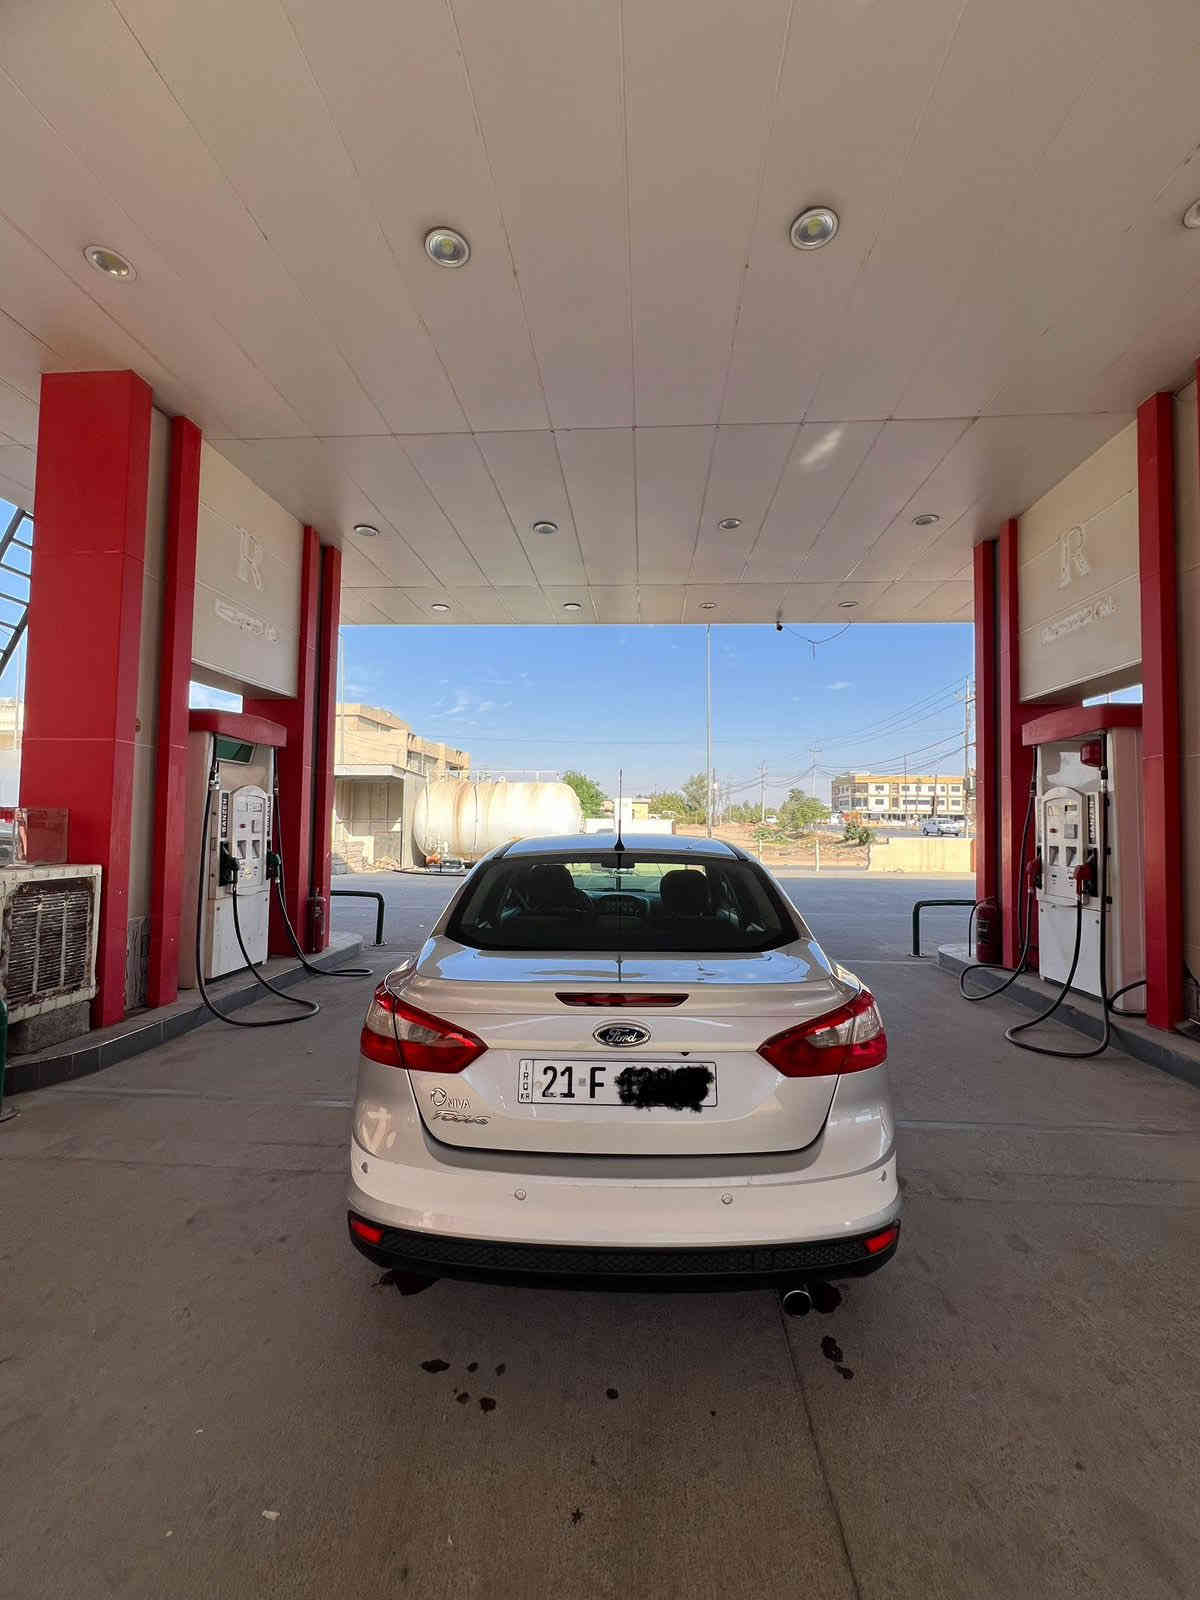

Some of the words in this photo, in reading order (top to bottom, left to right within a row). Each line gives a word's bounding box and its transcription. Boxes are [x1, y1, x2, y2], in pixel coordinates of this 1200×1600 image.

[605, 1027, 638, 1043] Ford
[541, 1065, 576, 1099] 21
[589, 1066, 607, 1099] F
